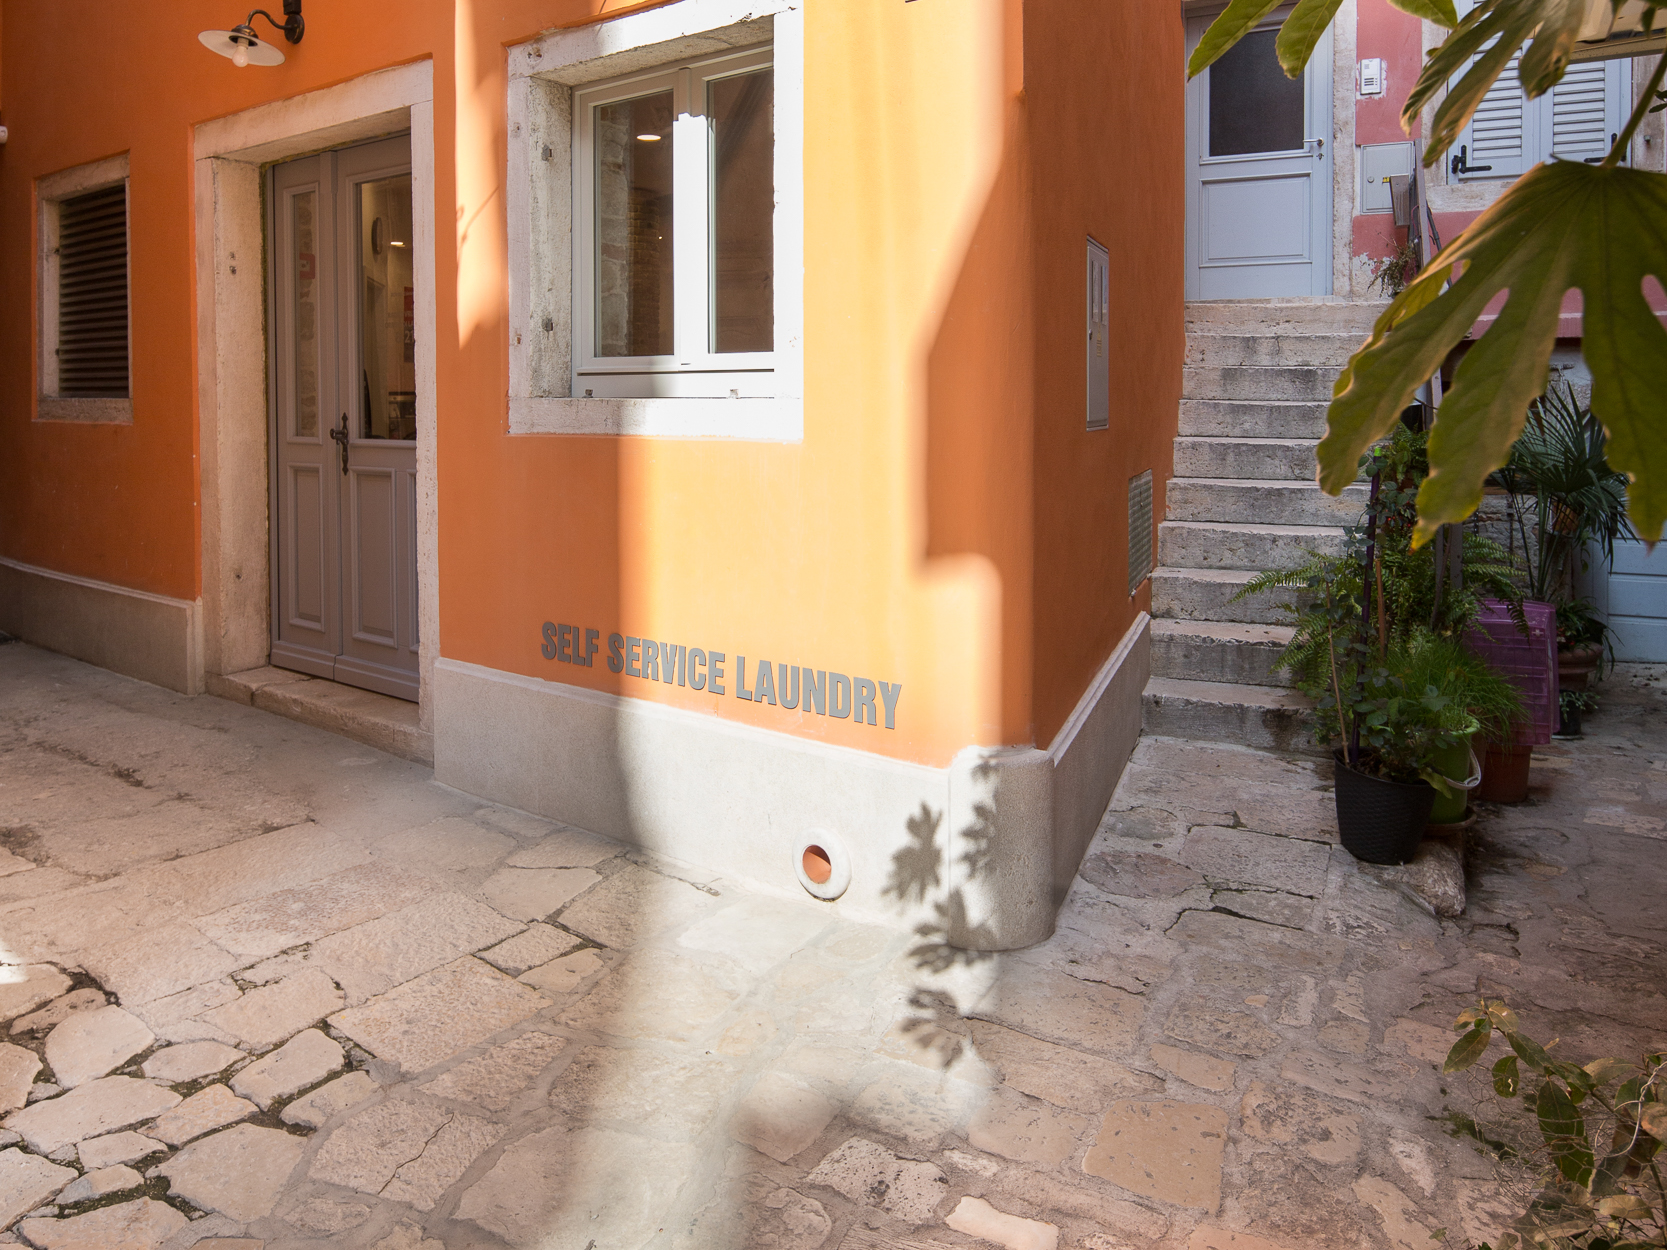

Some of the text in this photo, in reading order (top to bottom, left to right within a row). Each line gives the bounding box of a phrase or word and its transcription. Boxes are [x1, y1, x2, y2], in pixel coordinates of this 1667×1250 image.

[541, 621, 903, 730] SELF SERVICE LAUNDRY
